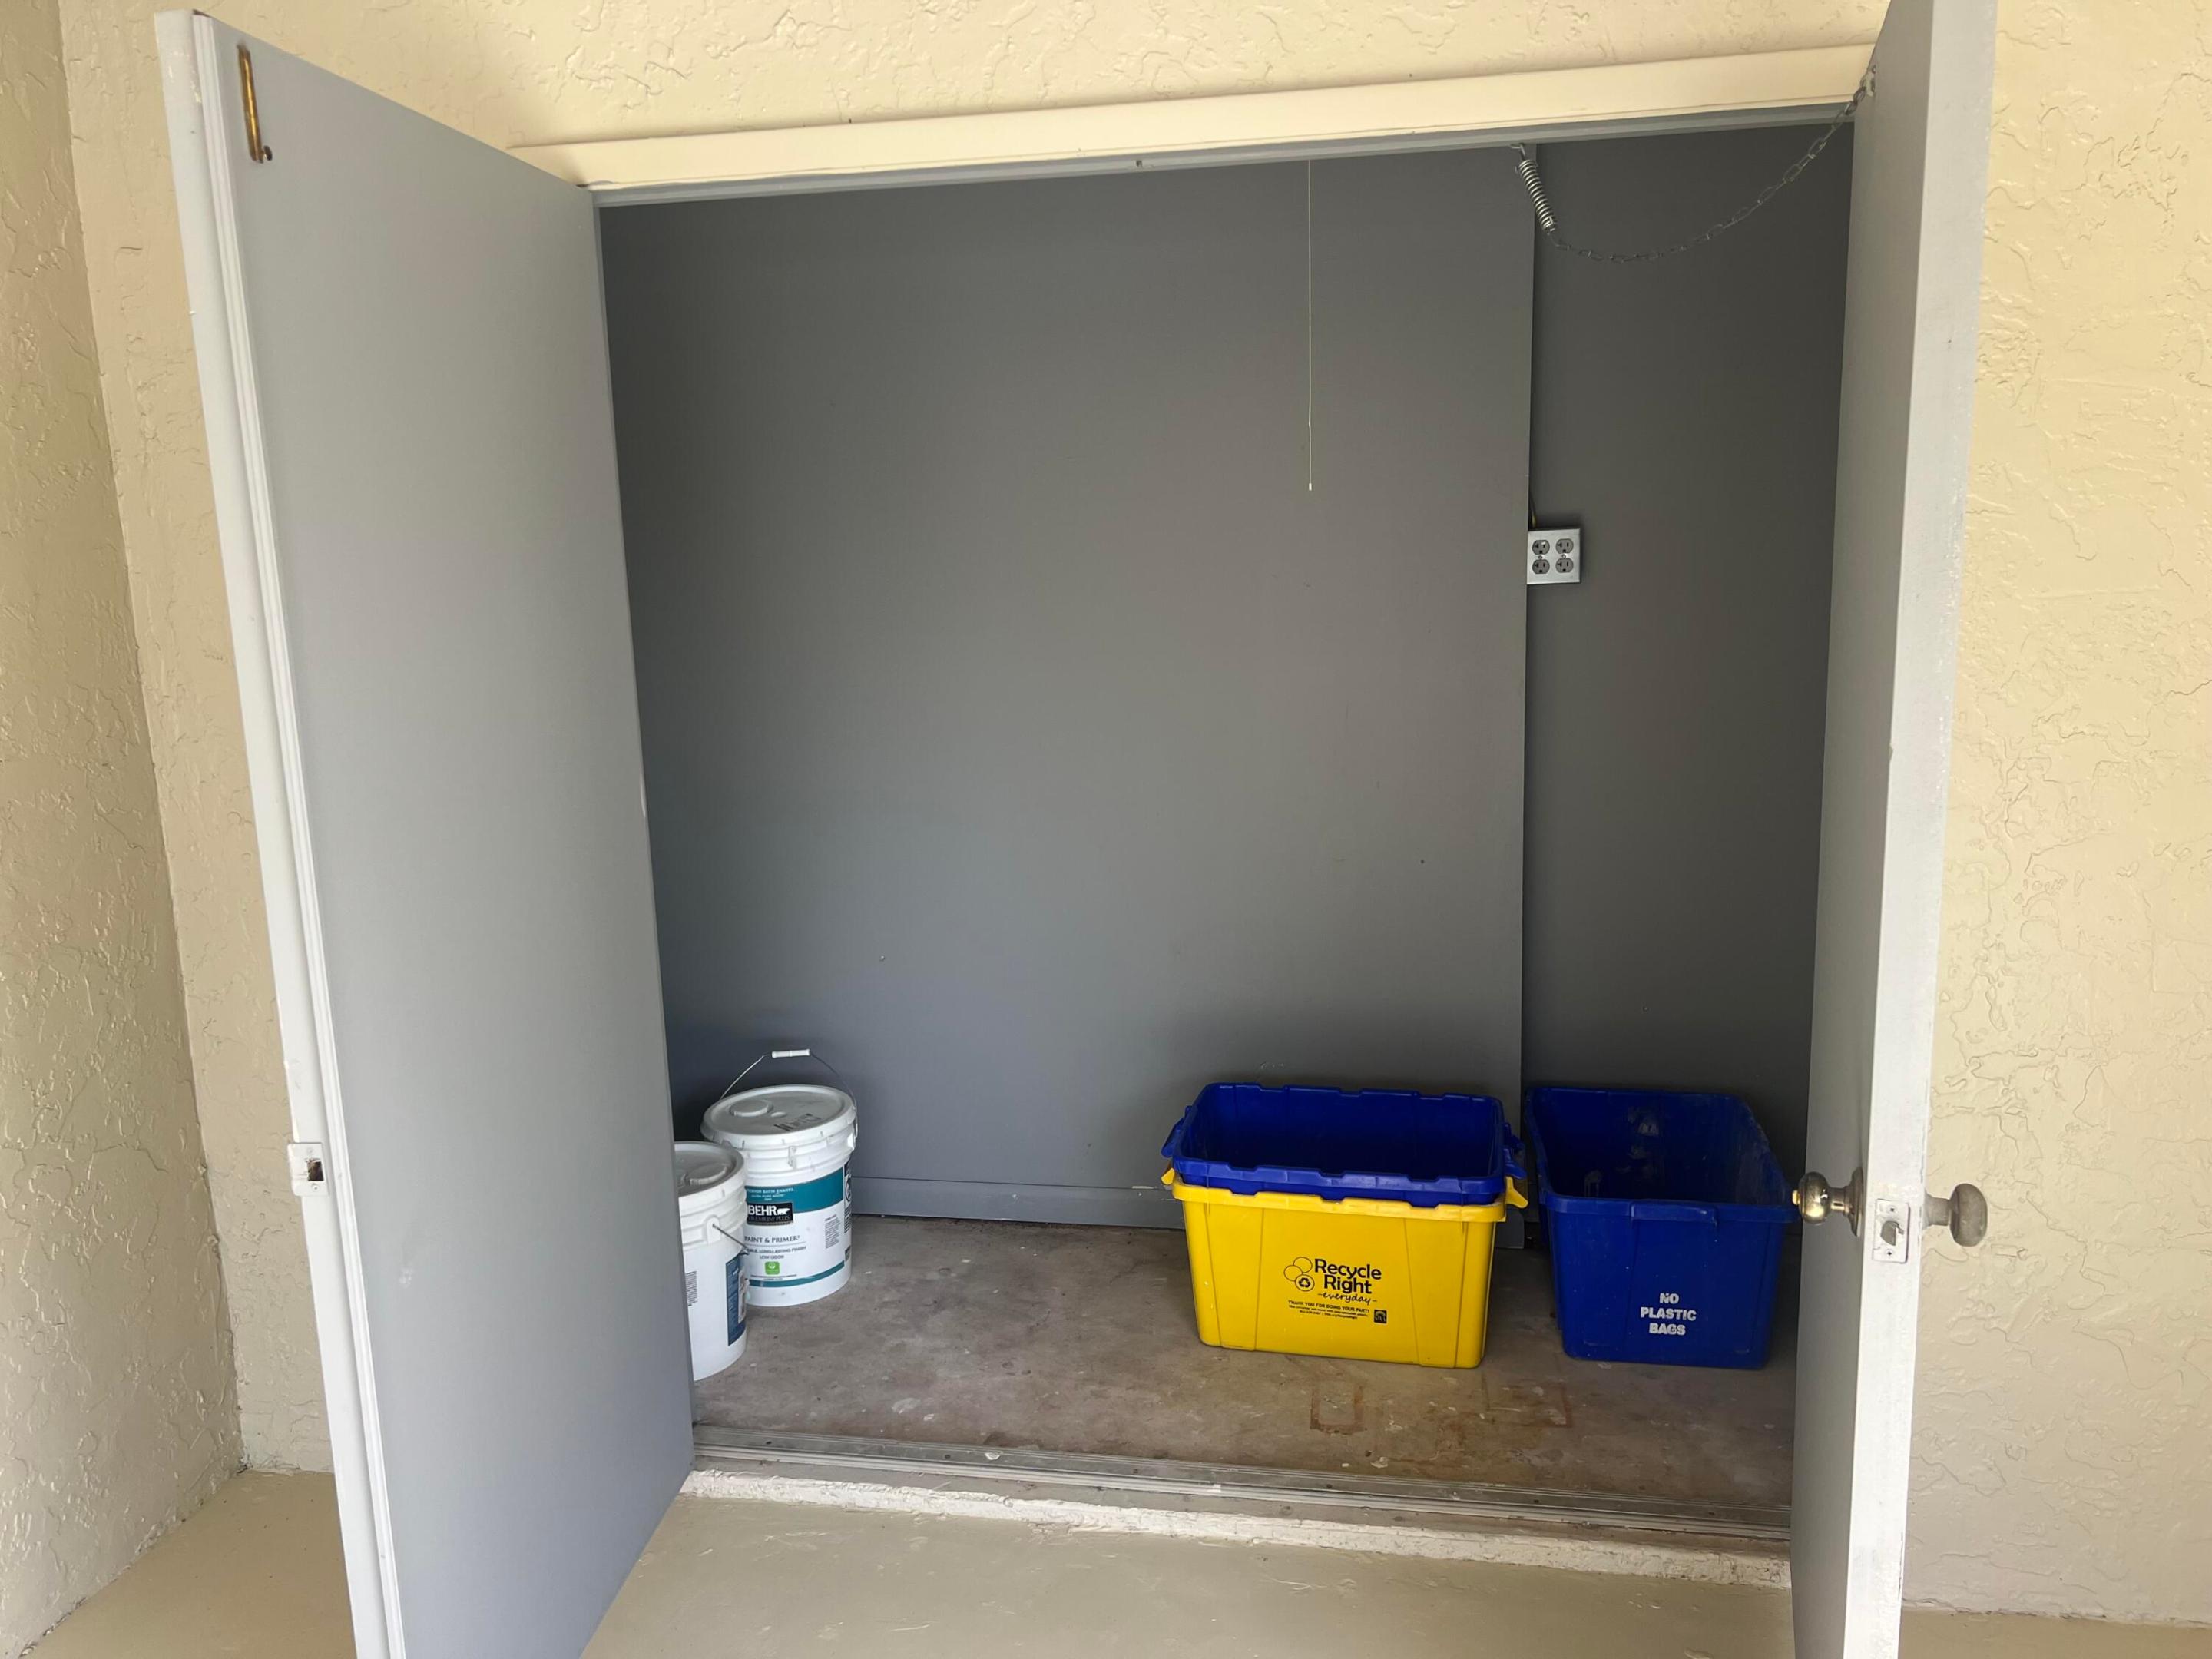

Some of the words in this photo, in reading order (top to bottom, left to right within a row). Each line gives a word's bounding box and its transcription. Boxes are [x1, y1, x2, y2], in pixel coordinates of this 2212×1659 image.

[748, 1205, 777, 1216] BEHR
[1314, 1258, 1382, 1280] Recycle
[1324, 1274, 1372, 1294] Right
[1659, 1292, 1680, 1304] NO
[1640, 1306, 1697, 1321] PLASTIC
[1649, 1323, 1686, 1336] BAGS
